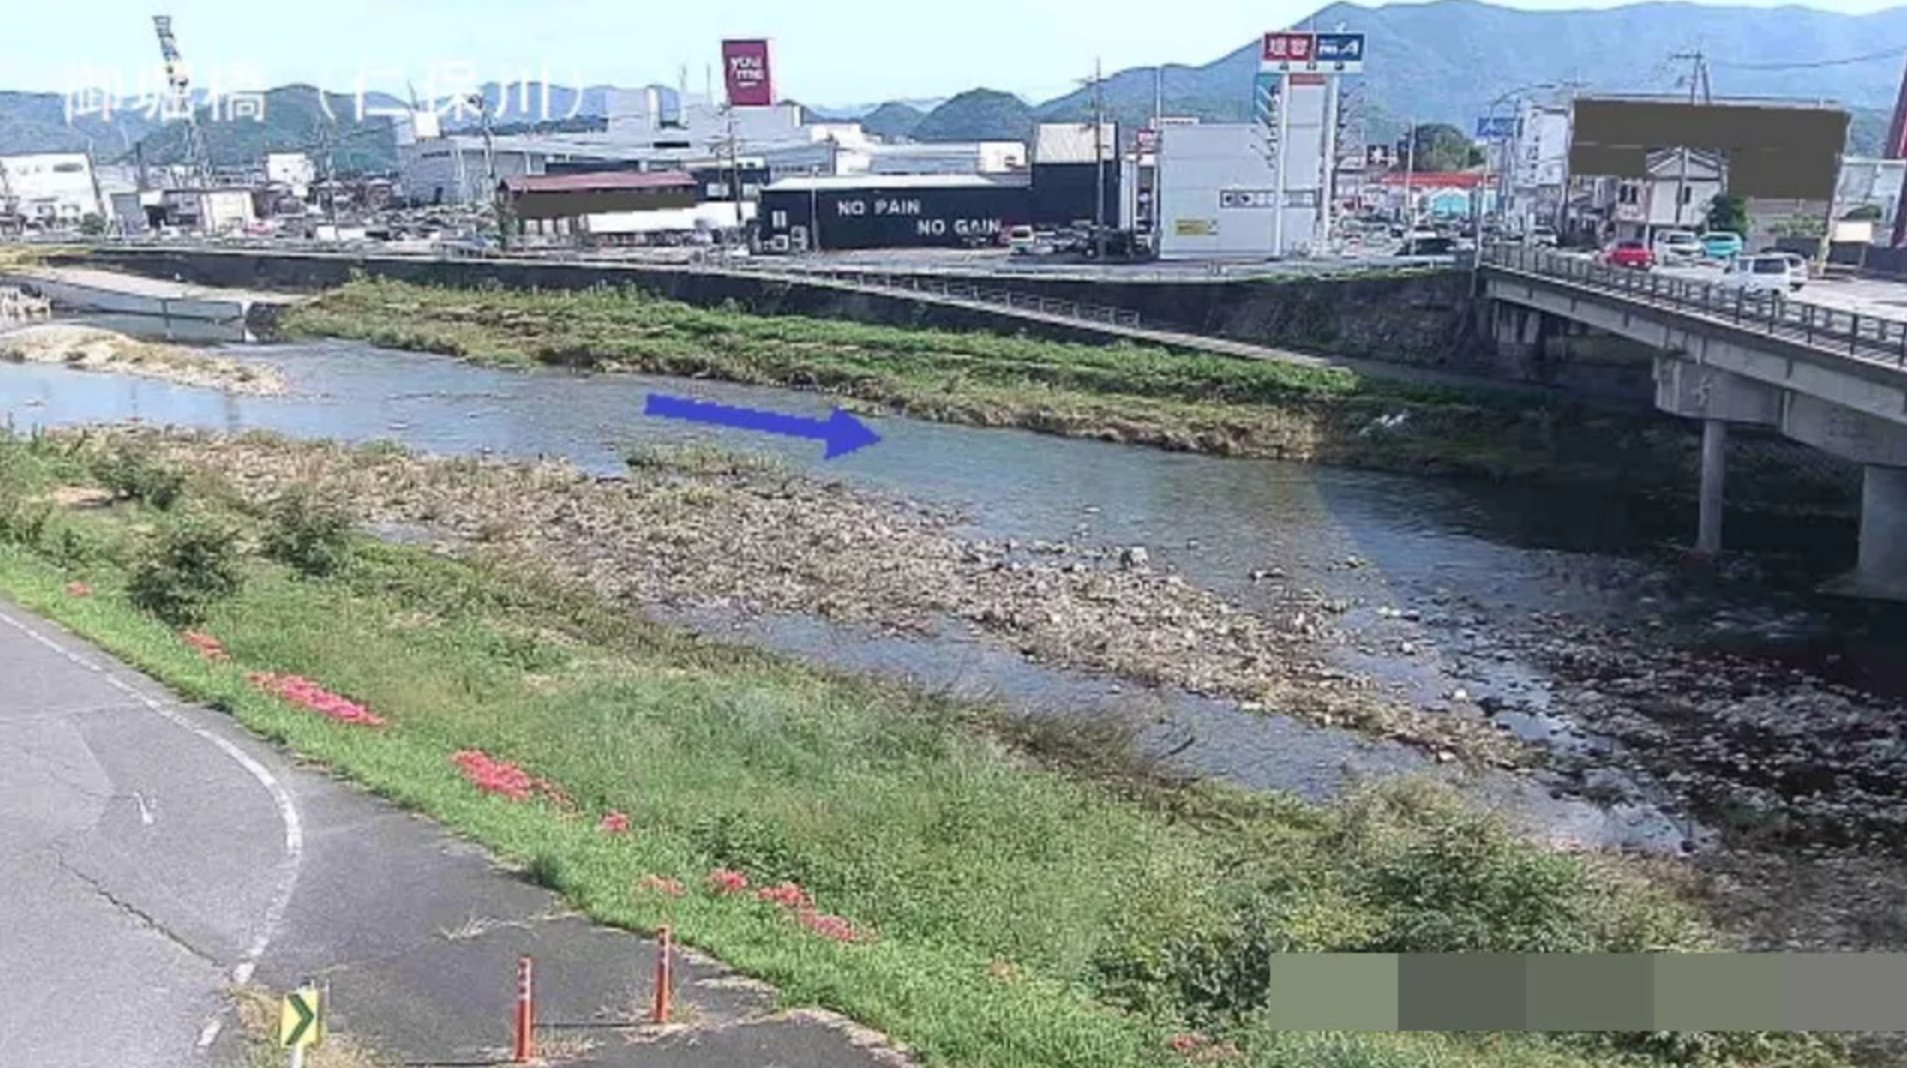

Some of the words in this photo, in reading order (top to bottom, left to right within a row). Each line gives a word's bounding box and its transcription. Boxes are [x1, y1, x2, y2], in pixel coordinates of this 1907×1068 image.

[737, 69, 764, 80] me
[837, 200, 865, 216] NO
[873, 198, 921, 215] PAIN
[917, 219, 946, 236] NO
[954, 218, 1001, 236] GAIN
